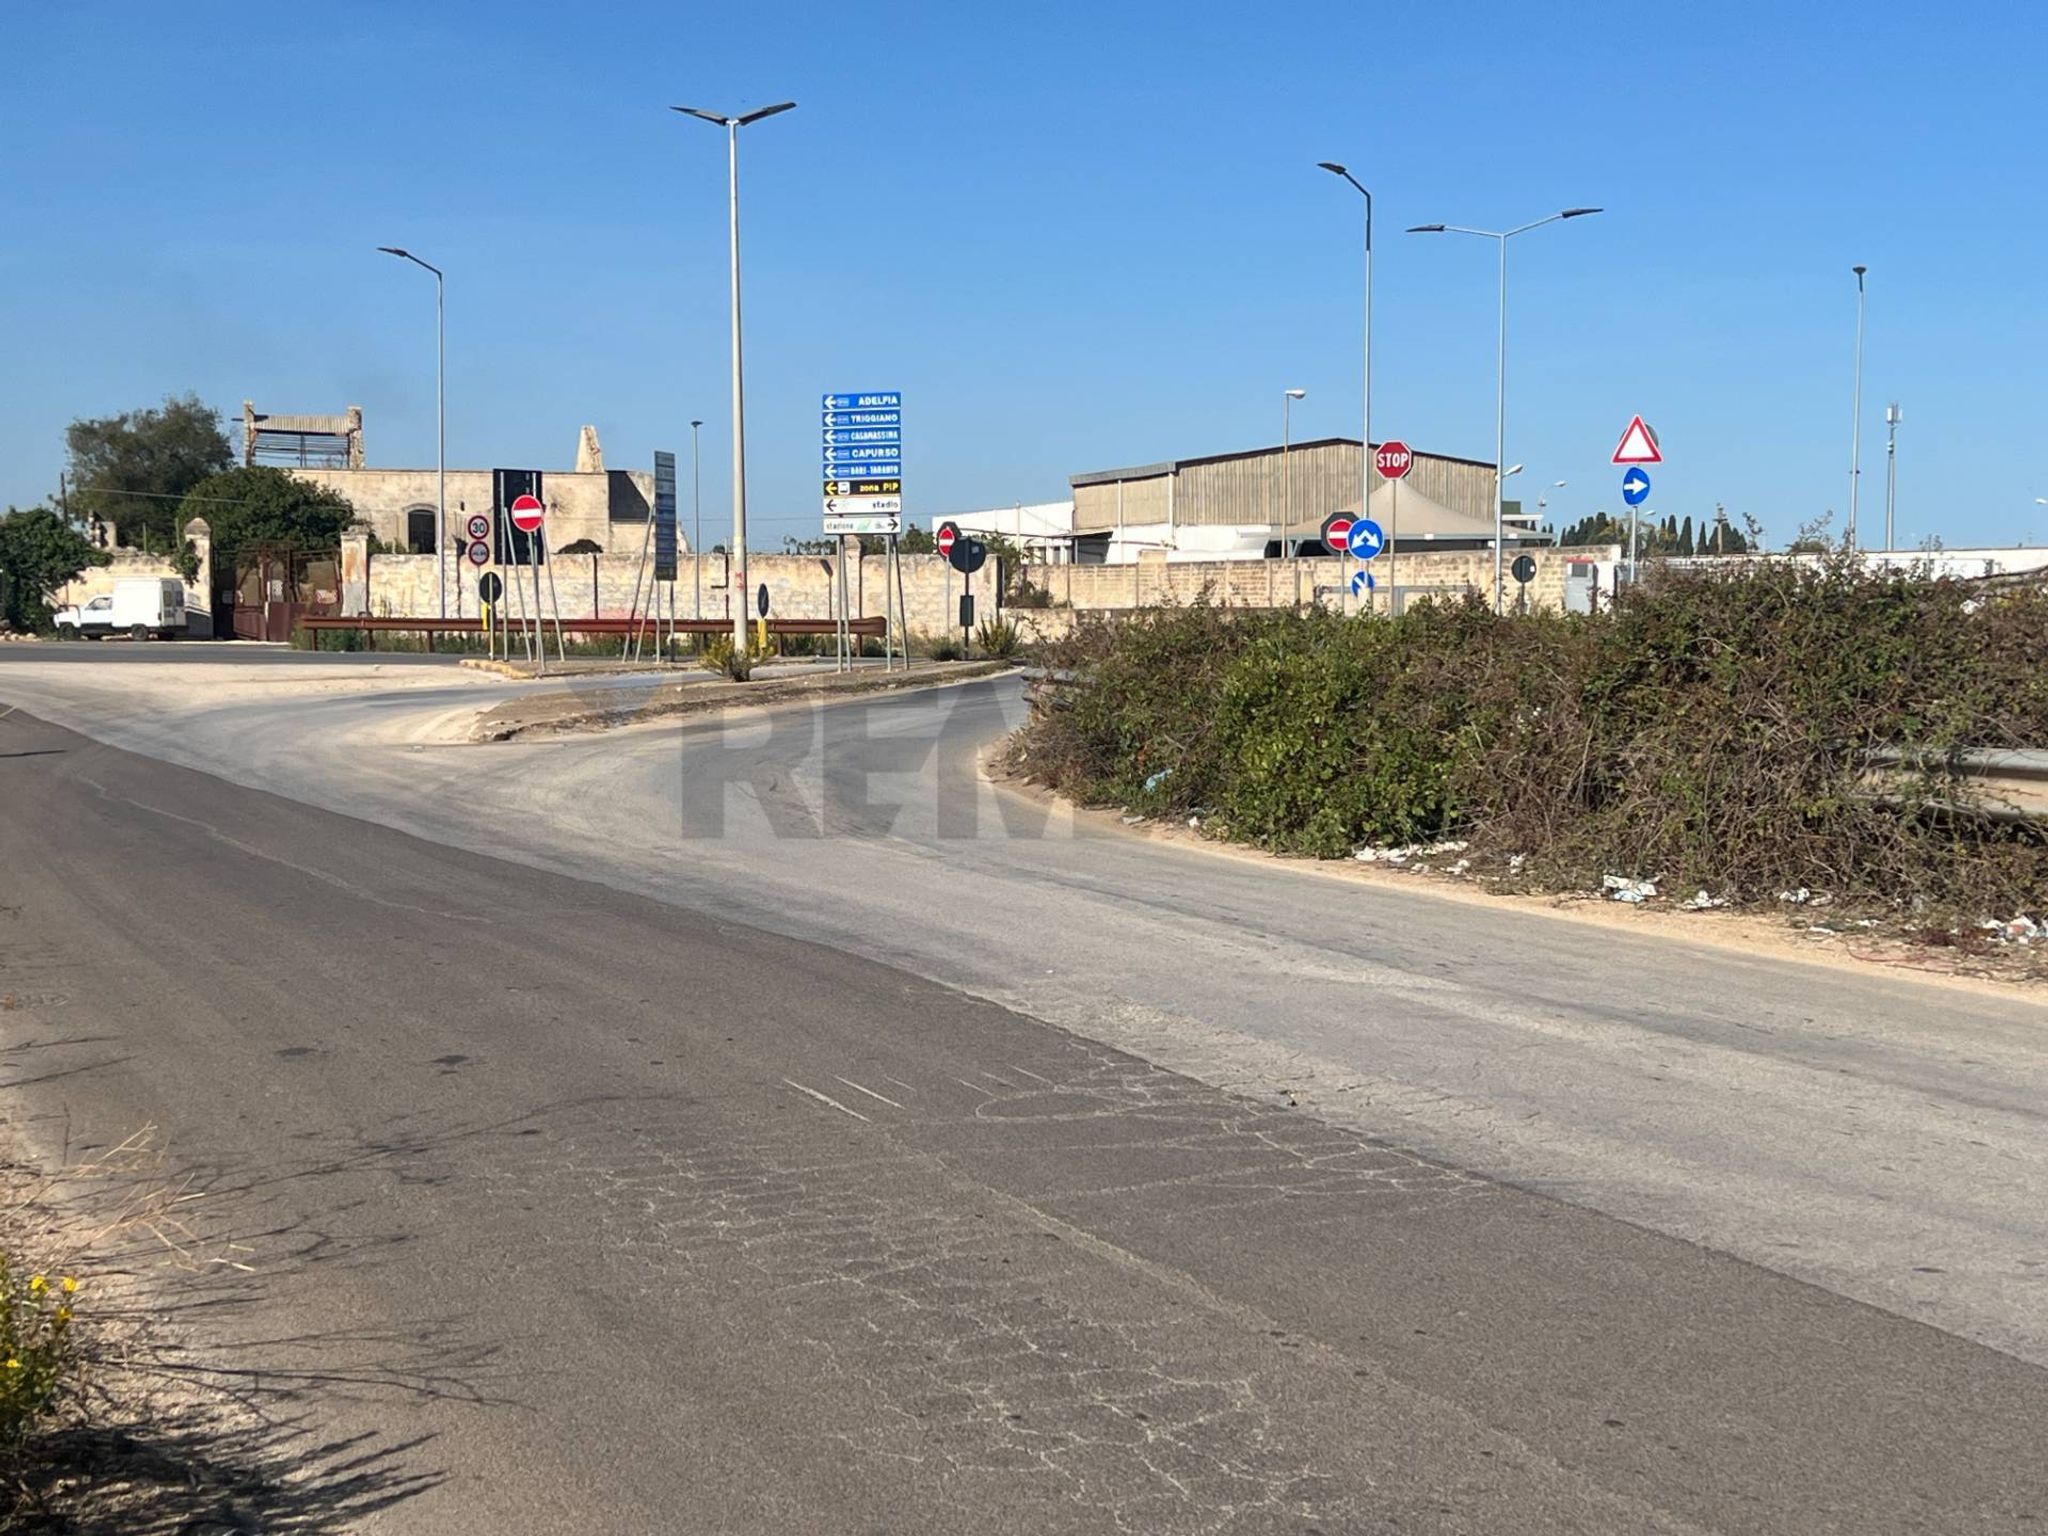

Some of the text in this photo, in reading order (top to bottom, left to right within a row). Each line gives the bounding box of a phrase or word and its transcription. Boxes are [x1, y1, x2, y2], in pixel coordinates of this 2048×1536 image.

[858, 395, 898, 406] ADELFIA
[852, 448, 898, 458] CAPURSO
[1378, 453, 1408, 468] STOP
[859, 482, 899, 492] zona PIP
[472, 522, 486, 534] 30
